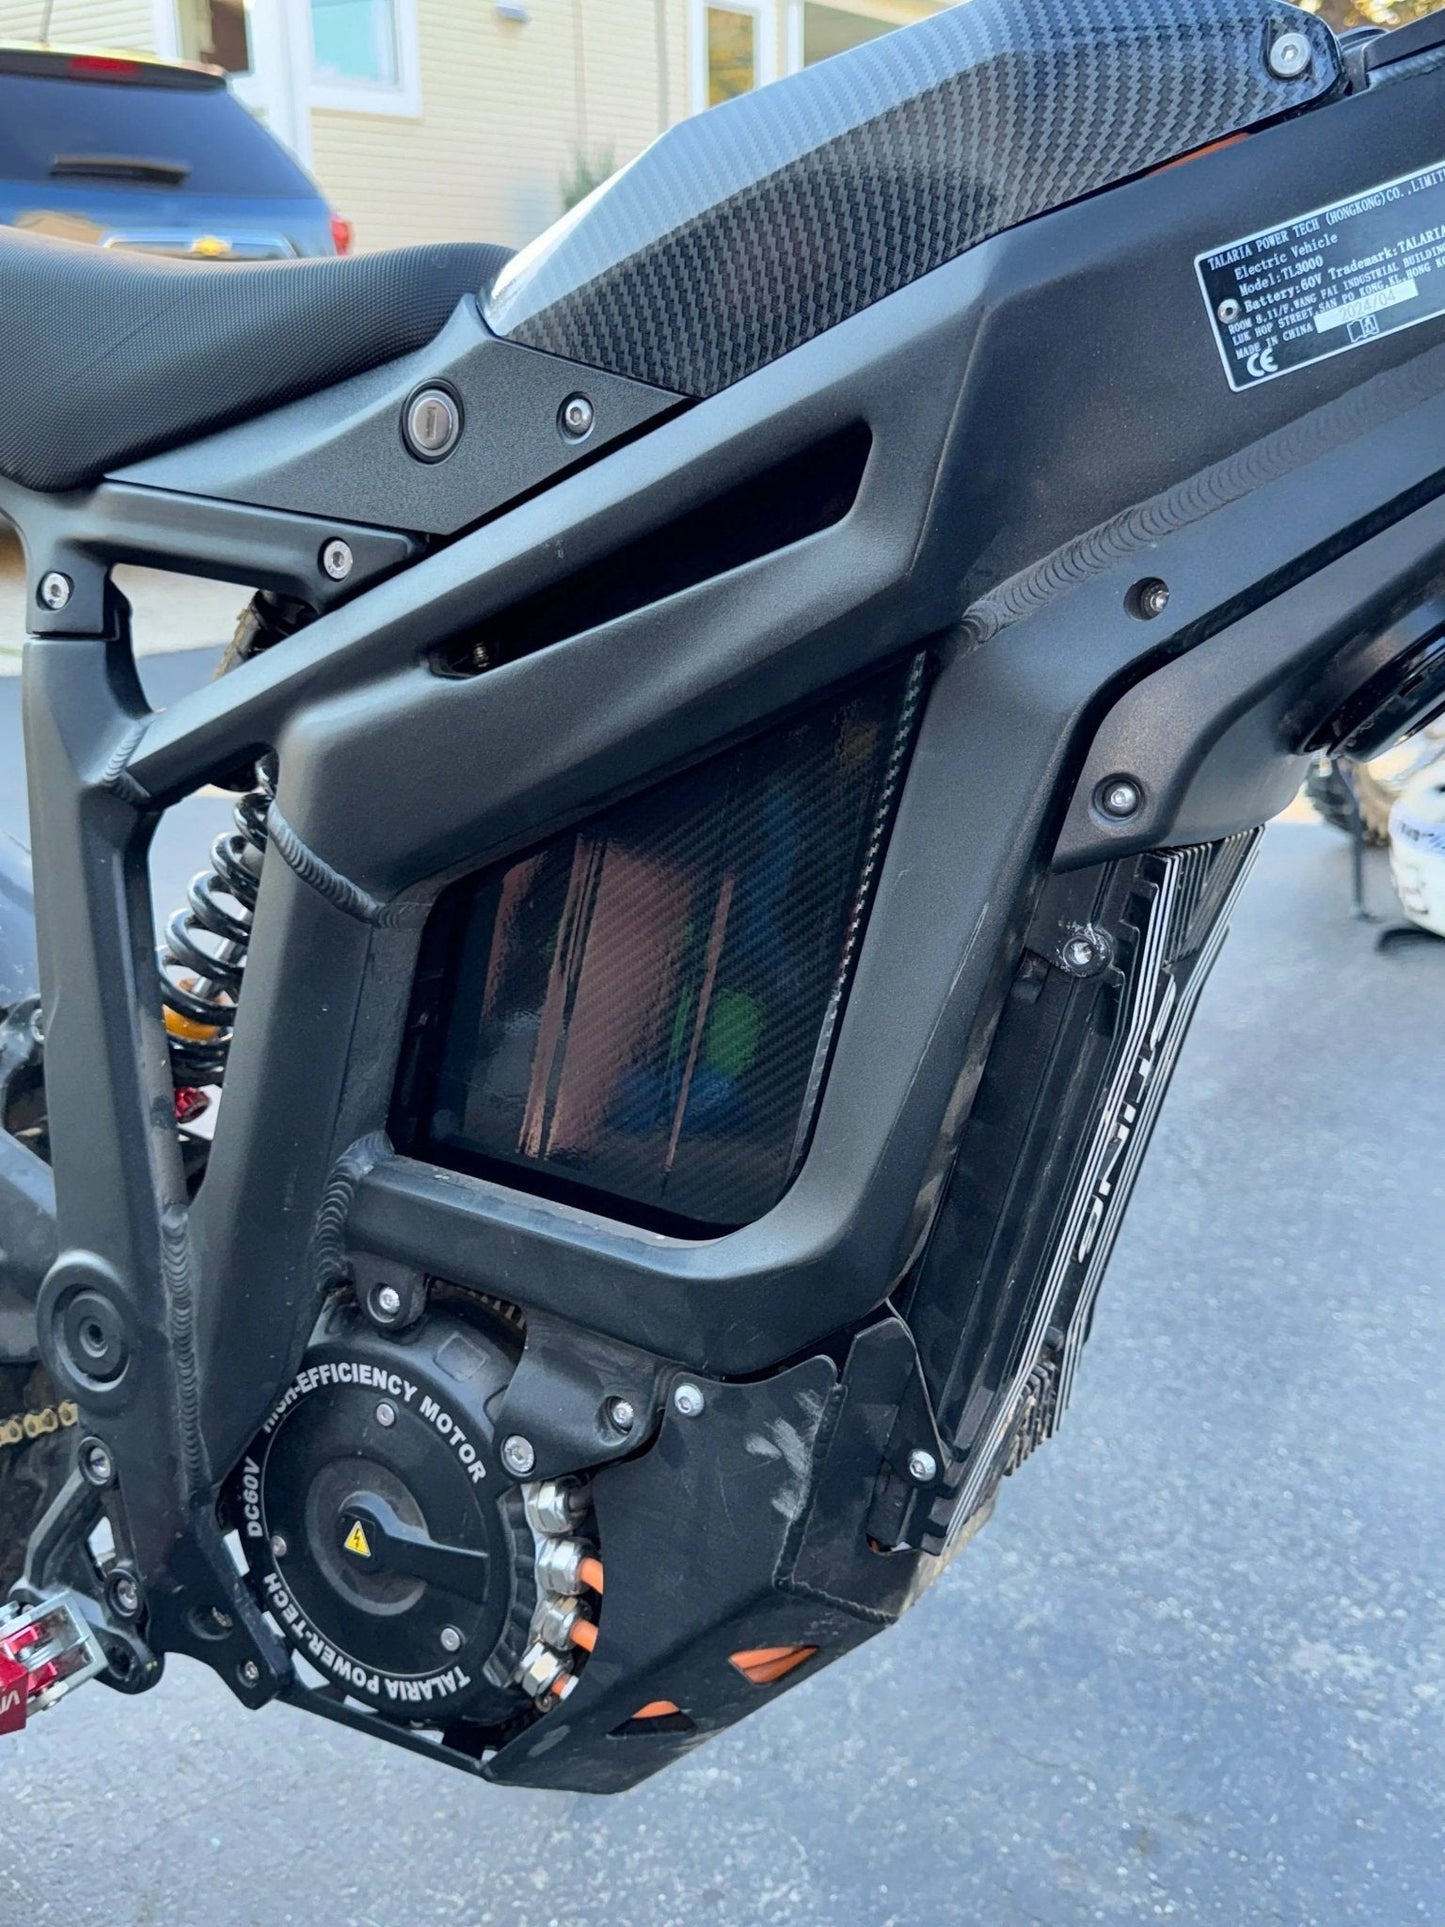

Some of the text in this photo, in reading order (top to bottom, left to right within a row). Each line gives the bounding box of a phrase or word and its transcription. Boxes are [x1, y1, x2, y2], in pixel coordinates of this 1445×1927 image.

[1208, 244, 1253, 271] TALARIA
[1256, 230, 1290, 252] POWER
[1293, 217, 1320, 238] TECH
[1234, 233, 1338, 281] Electric Vehicle
[1228, 317, 1252, 335] ROOM
[1321, 284, 1338, 300] FAI
[1343, 261, 1400, 291] INDUSTRIAL
[1239, 255, 1324, 297] Model:TL3000
[1244, 273, 1323, 313] Battery:60V
[1232, 331, 1252, 346] LUK
[1254, 322, 1273, 338] HOP
[1342, 291, 1355, 305] PO
[1339, 288, 1396, 320] 2024/04
[1235, 323, 1314, 360] MADE IN CHINA
[1246, 347, 1279, 378] CE
[419, 1396, 487, 1484] MOTOR
[245, 1456, 263, 1538] DC60V
[262, 1573, 472, 1703] TALARIA POWER-TECH
